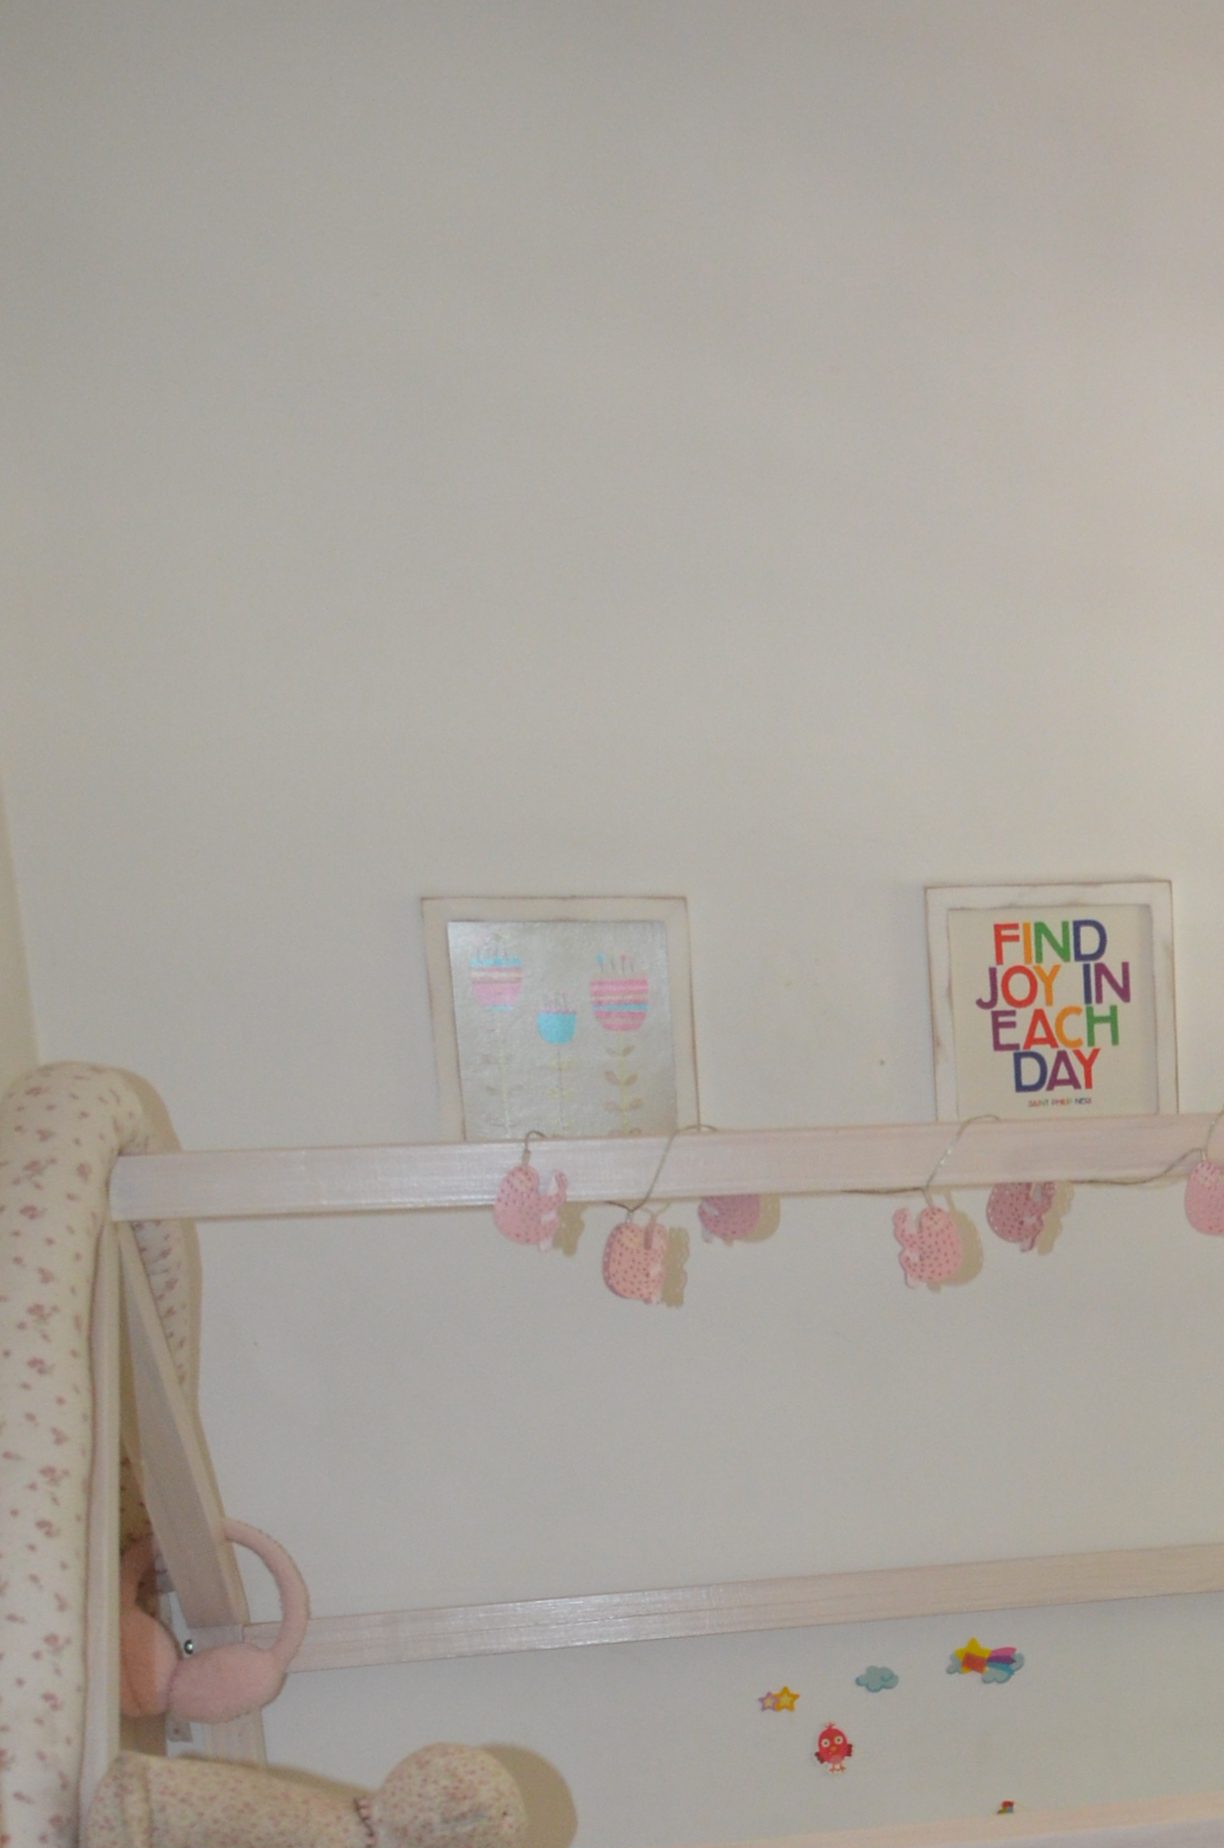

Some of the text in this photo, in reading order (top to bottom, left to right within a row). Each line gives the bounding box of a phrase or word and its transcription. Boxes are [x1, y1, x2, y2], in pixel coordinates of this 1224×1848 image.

[993, 919, 1107, 965] FIND
[975, 961, 1131, 1010] JOY IN
[990, 1004, 1119, 1052] EACH
[1013, 1048, 1101, 1093] DAY
